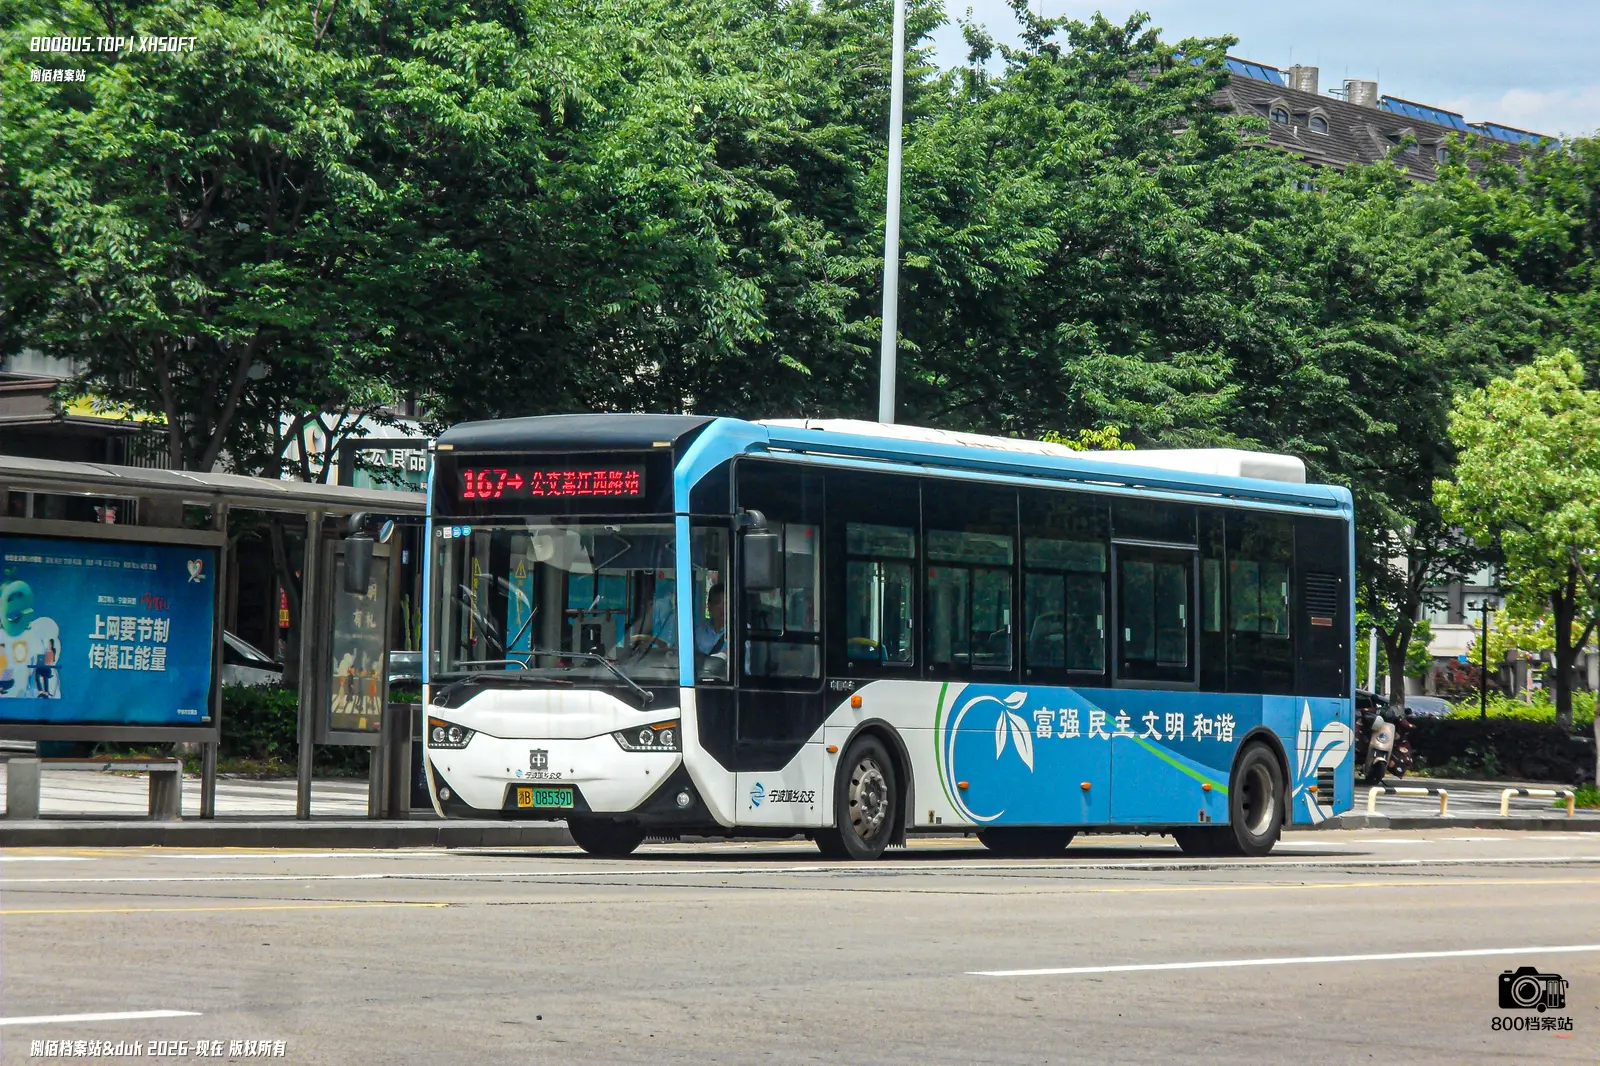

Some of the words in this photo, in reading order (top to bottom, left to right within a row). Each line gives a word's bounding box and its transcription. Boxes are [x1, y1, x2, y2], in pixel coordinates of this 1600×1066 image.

[463, 469, 508, 498] 167
[88, 614, 170, 643] 上网要节制
[88, 643, 167, 672] 传播正能量
[768, 789, 815, 804] 宁波城乡公交
